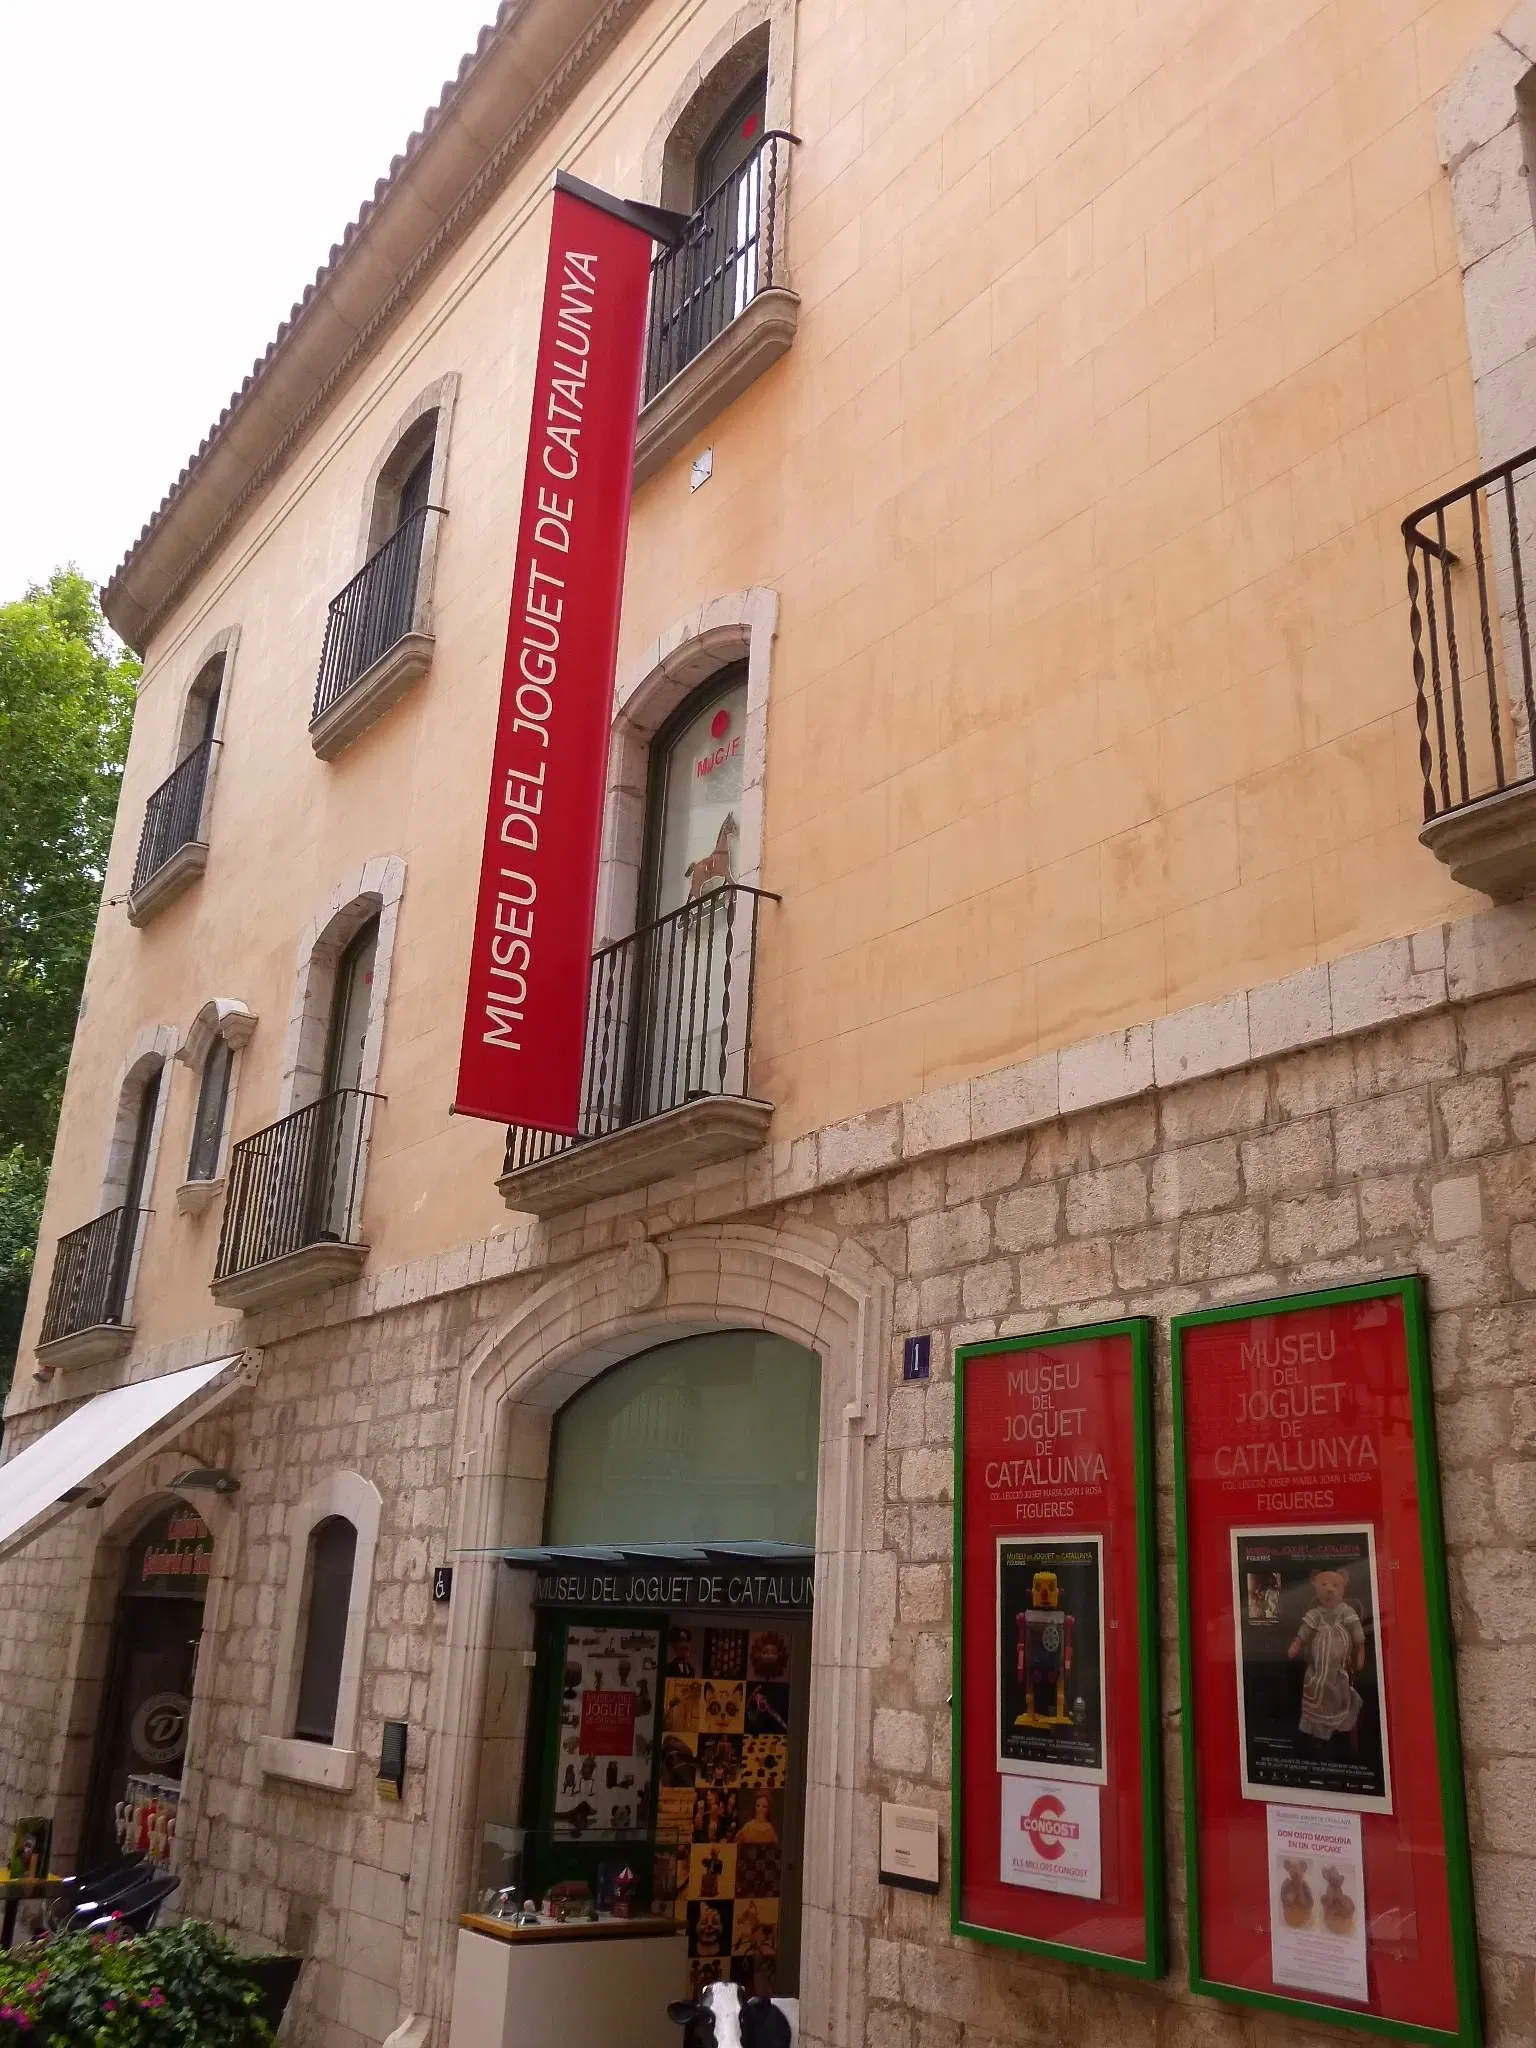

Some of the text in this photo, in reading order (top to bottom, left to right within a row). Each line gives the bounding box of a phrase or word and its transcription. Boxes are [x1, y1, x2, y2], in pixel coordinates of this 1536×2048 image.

[482, 250, 599, 1051] MUSEU DEL JOGUET DE CATALUNYA
[914, 1343, 919, 1371] 1
[1240, 1329, 1337, 1371] MUSEU
[1007, 1362, 1081, 1396] MUSEU
[1273, 1367, 1304, 1386] DEL
[1032, 1394, 1055, 1411] DEL
[1235, 1382, 1347, 1424] JOGUET
[1002, 1408, 1088, 1442] JOGUET
[1280, 1420, 1303, 1438] DE
[1036, 1440, 1053, 1456] DE
[1214, 1434, 1378, 1477] CATALUNYA
[984, 1453, 1108, 1489] CATALUNYA
[1016, 1501, 1075, 1520] FIGUERES
[1257, 1489, 1335, 1511] FIGUERES
[536, 1575, 588, 1600] MUSEU
[591, 1576, 621, 1601] DEL
[625, 1575, 694, 1602] JOGUET
[699, 1576, 723, 1603] DE
[1023, 1818, 1077, 1837] CONGOST
[1277, 1829, 1293, 1838] DON
